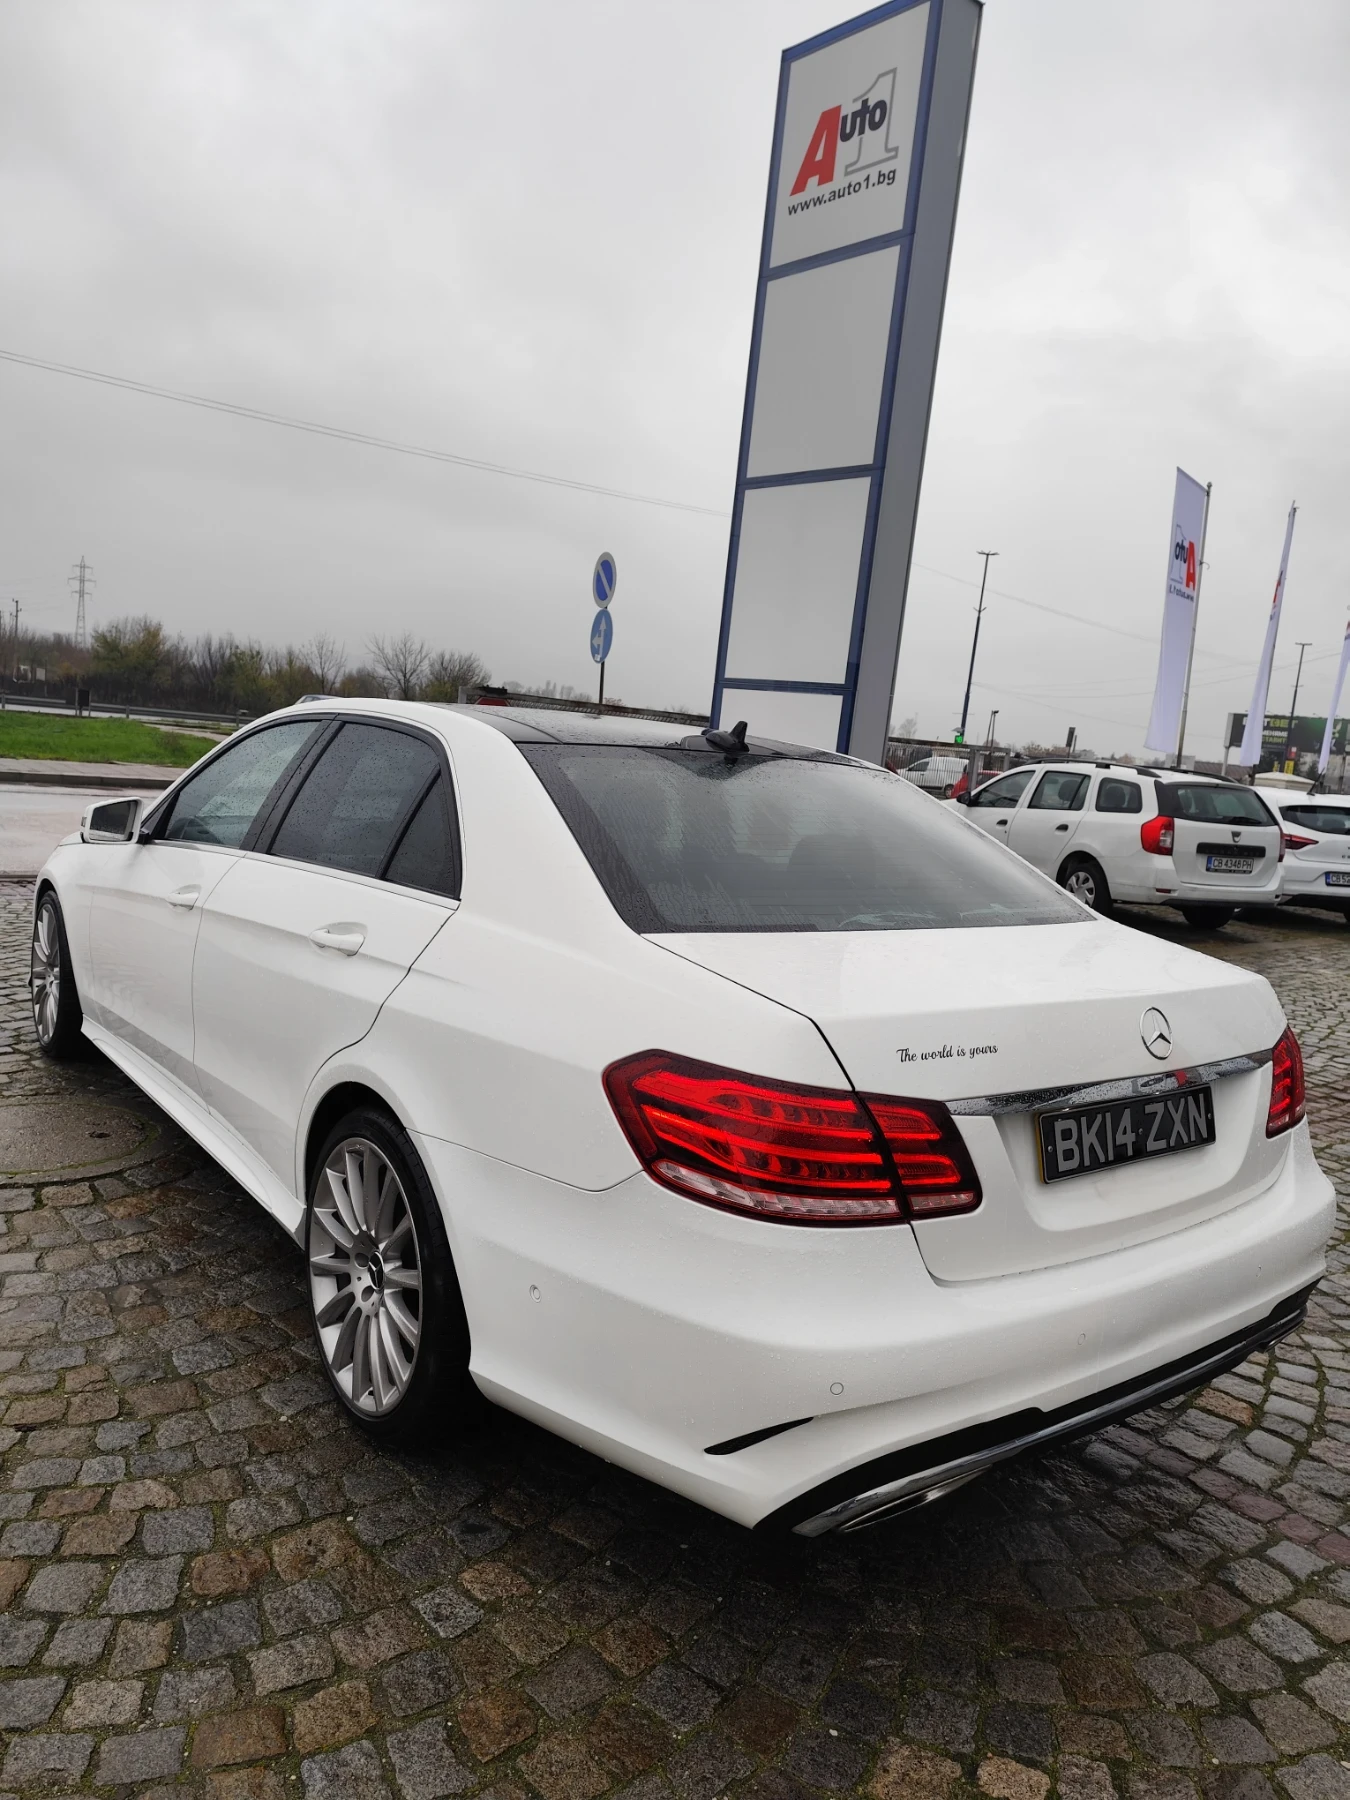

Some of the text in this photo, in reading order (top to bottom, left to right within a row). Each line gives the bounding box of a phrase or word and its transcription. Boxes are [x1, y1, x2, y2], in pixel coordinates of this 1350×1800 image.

[790, 98, 887, 196] Auto
[788, 169, 897, 216] www.auto1.bg
[896, 1044, 998, 1063] The world is yours
[1054, 1093, 1208, 1173] BK14 ZXN
